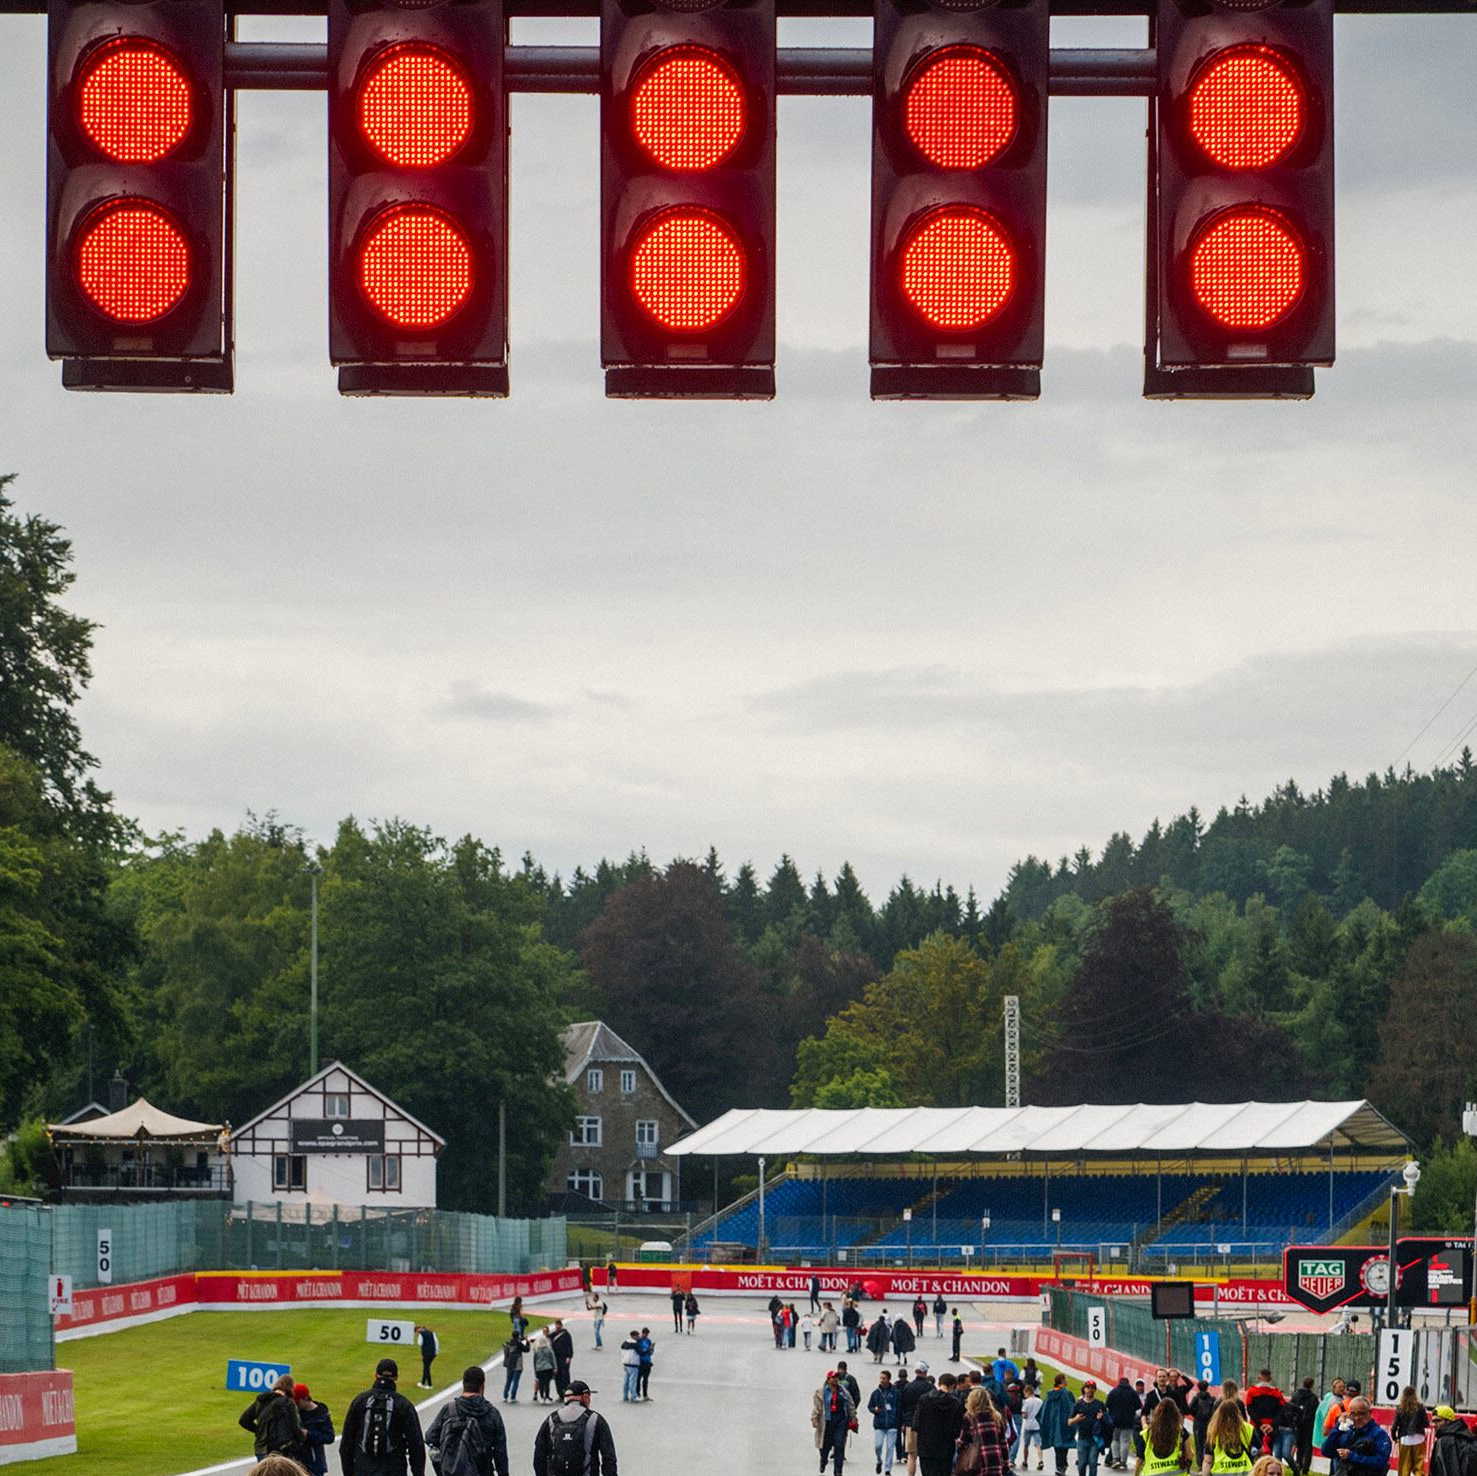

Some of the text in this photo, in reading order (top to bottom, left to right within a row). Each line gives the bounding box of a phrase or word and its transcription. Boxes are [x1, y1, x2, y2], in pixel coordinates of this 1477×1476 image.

[99, 1240, 110, 1272] 50
[1303, 1263, 1341, 1275] TAG
[737, 1273, 773, 1288] MOËT
[776, 1277, 784, 1288] &
[891, 1278, 1011, 1294] MOËT & CHANDON
[1300, 1277, 1343, 1295] HEUER
[1217, 1285, 1254, 1301] MOËT
[1257, 1290, 1267, 1300] &
[379, 1325, 401, 1341] 50
[1092, 1316, 1100, 1341] 50
[1386, 1333, 1400, 1401] 150
[238, 1366, 279, 1390] 100
